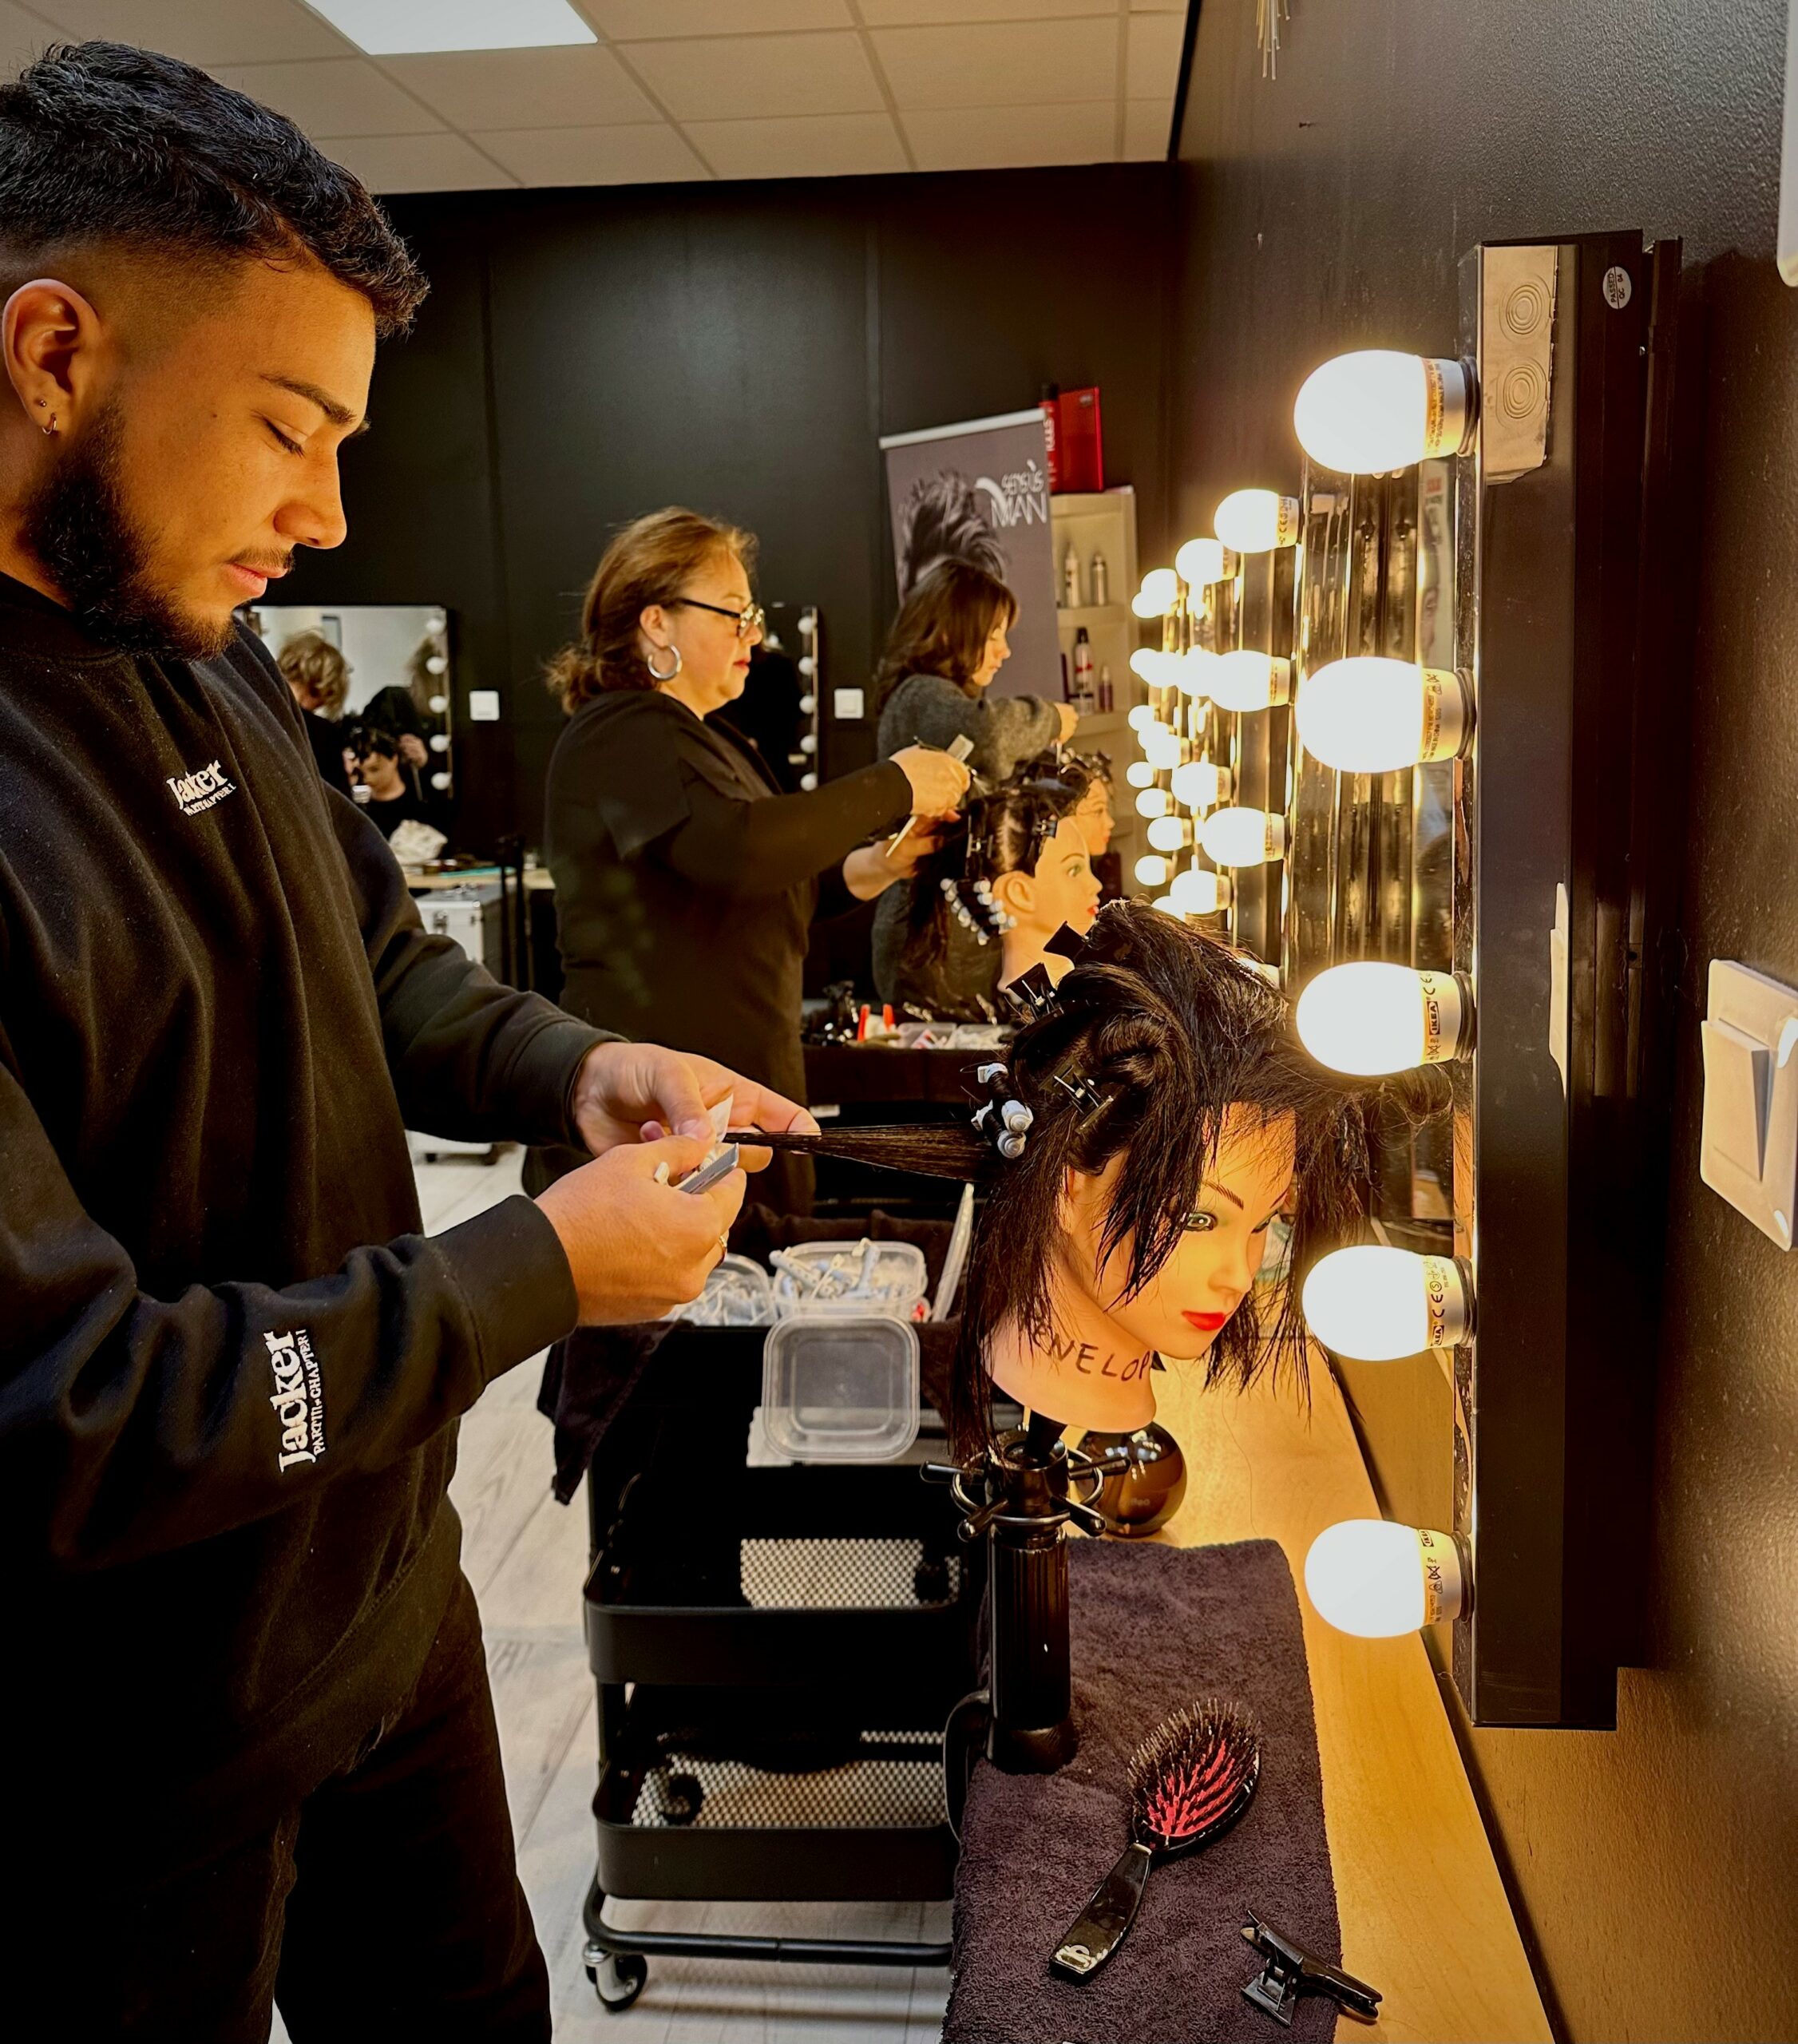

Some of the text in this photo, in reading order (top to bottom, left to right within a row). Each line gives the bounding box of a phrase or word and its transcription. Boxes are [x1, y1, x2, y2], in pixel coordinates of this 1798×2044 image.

[1608, 272, 1617, 303] PASSED
[1618, 287, 1626, 299] QC
[991, 492, 1047, 528] MAN
[1429, 1004, 1438, 1031] IKEA
[263, 1331, 316, 1473] Jacker
